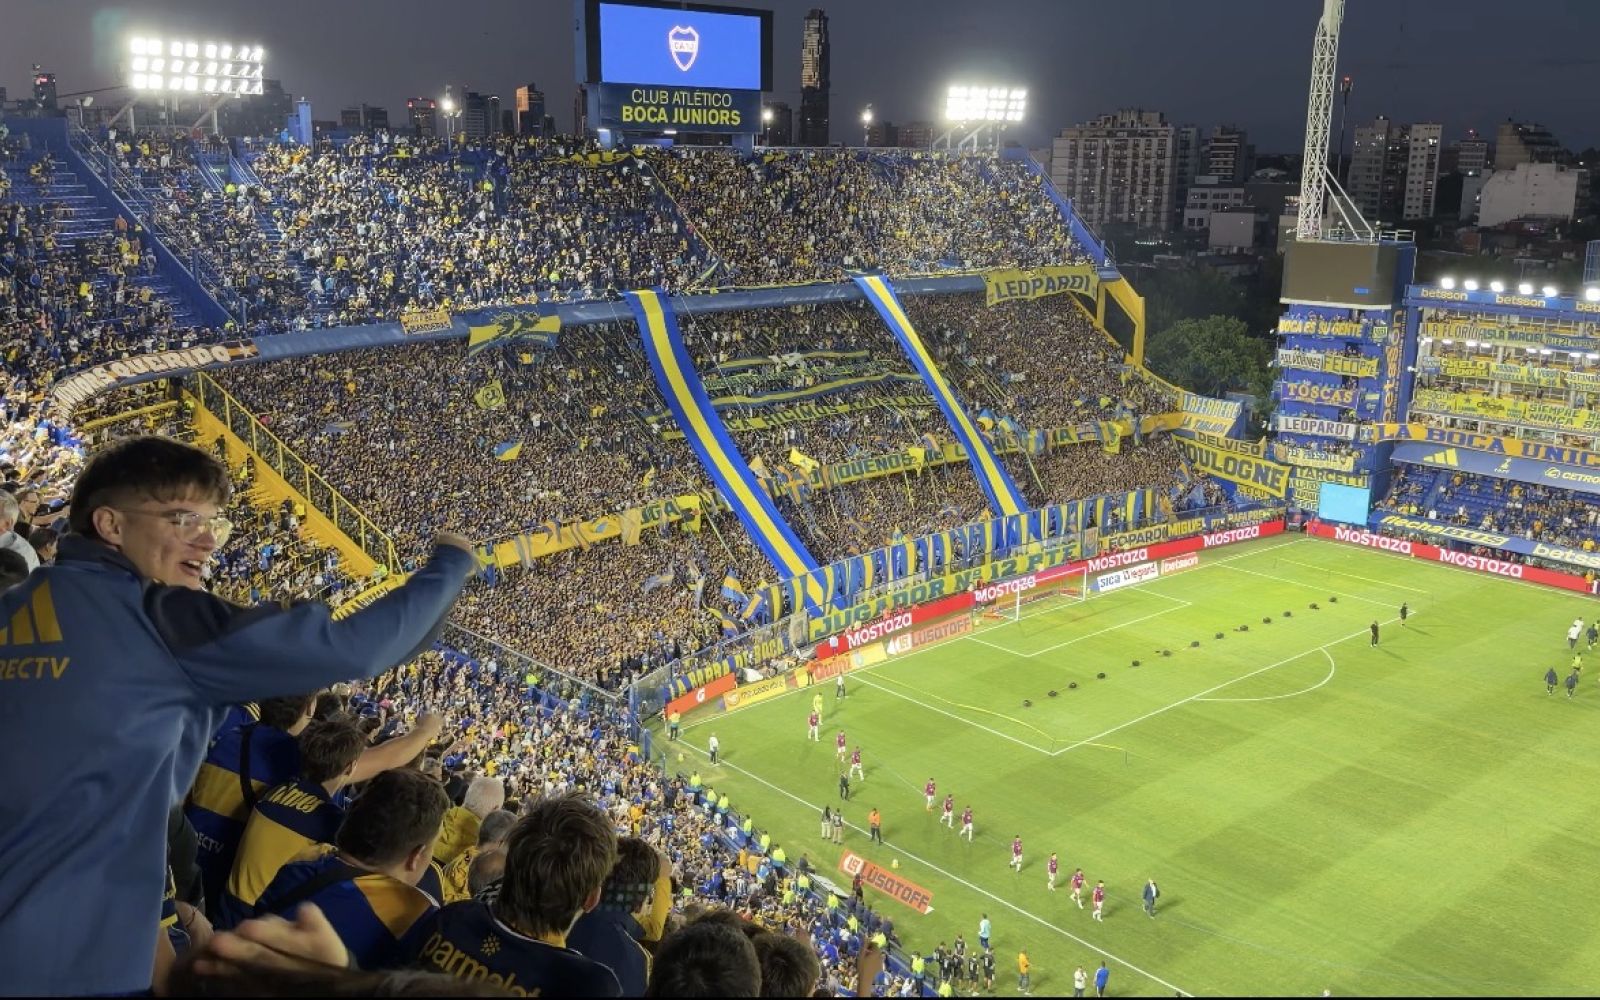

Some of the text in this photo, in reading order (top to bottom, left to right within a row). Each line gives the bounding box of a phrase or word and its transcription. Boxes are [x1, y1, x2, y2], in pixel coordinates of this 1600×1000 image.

[631, 88, 733, 107] CLUB ATLÉTICO
[622, 105, 741, 126] BOCA JUNIORS
[995, 274, 1091, 300] LEOPARDI
[1421, 288, 1468, 301] betsson
[1495, 293, 1546, 308] betsson
[1442, 323, 1482, 340] FLORIDA
[109, 345, 231, 378] QUERIDO
[1288, 383, 1353, 403] TOSCAS
[1530, 404, 1579, 418] SIEMPRE
[1284, 418, 1350, 436] LEOPARDI
[1198, 432, 1261, 456] DELVISO
[1427, 428, 1505, 453] BOCA
[1166, 517, 1206, 538] MIGUEL
[814, 578, 944, 639] JUGADOR
